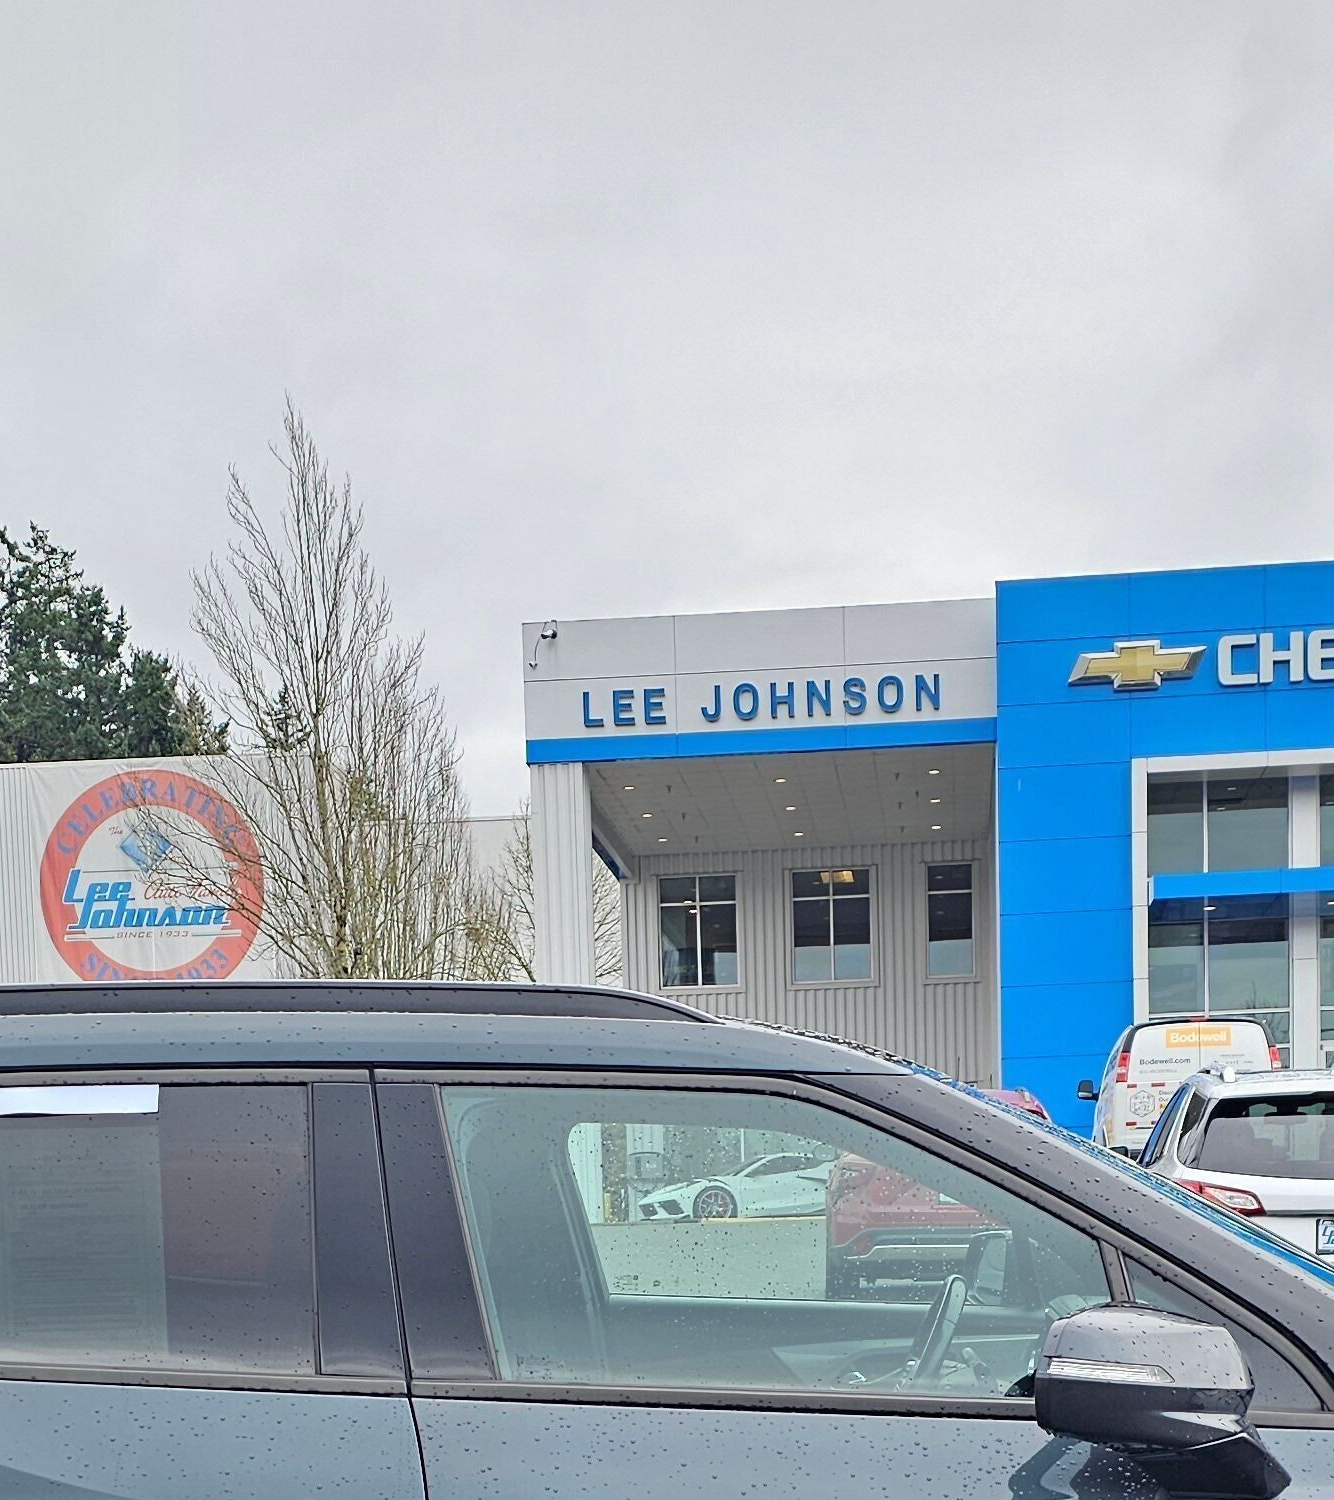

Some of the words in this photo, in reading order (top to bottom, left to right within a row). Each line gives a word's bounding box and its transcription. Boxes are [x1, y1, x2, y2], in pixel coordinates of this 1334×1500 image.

[582, 688, 666, 727] LEE
[701, 673, 941, 722] JOHNSON
[56, 777, 240, 855] CELEBRATING
[63, 869, 135, 903] Lee
[68, 896, 230, 931] Johnson
[116, 931, 153, 939] SINCE
[159, 930, 189, 938] 1933
[1170, 1030, 1227, 1044] Bodewell
